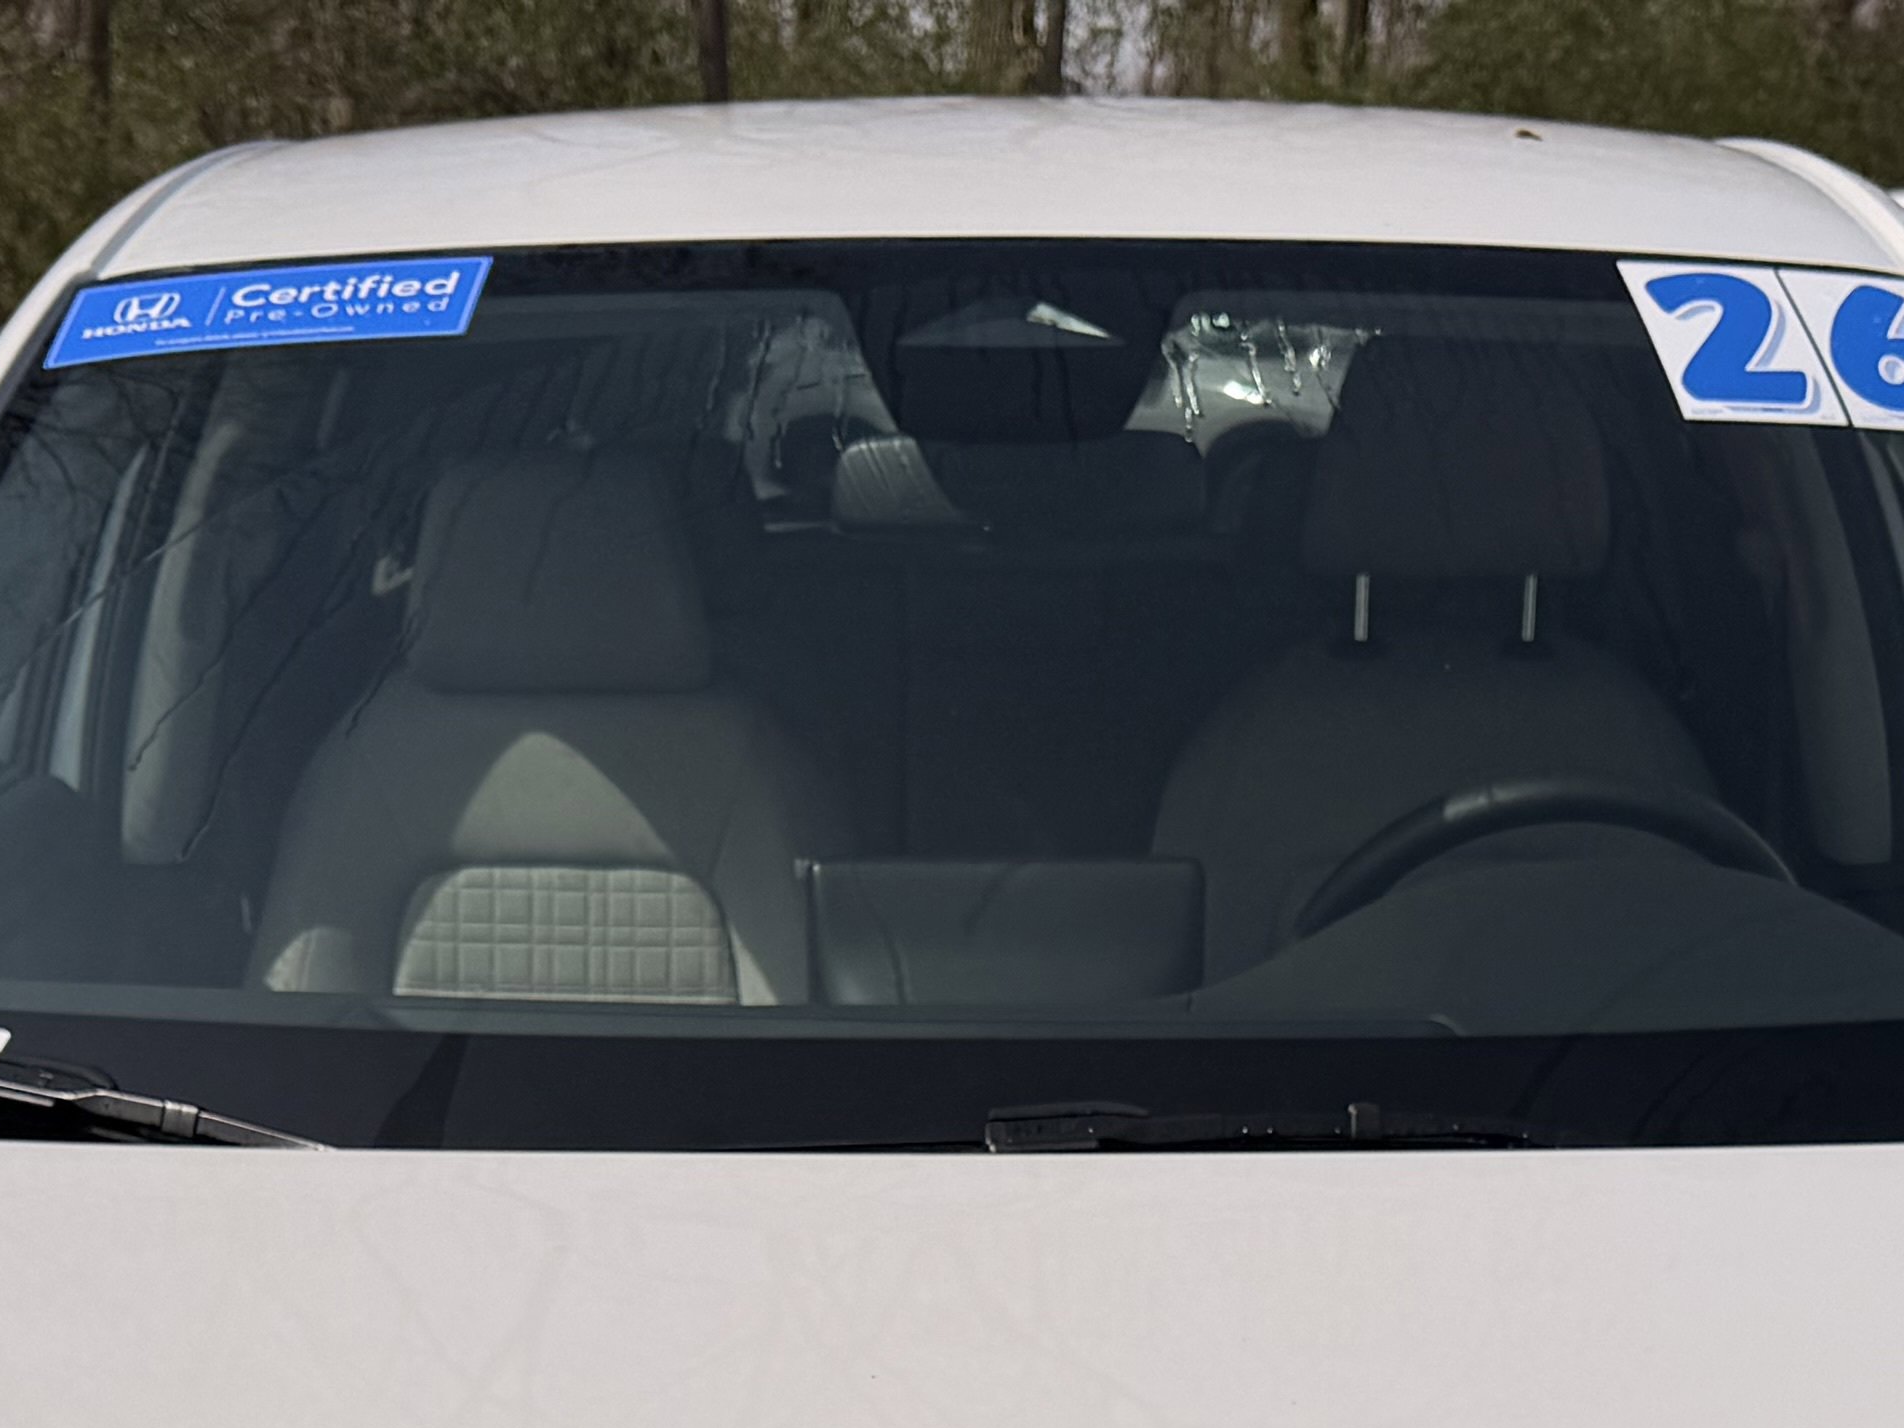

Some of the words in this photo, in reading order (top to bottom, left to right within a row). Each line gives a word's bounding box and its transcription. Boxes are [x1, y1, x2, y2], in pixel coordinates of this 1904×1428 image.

[231, 270, 460, 307] Certified
[223, 297, 449, 324] Pre-Owned
[81, 317, 192, 339] HONDA
